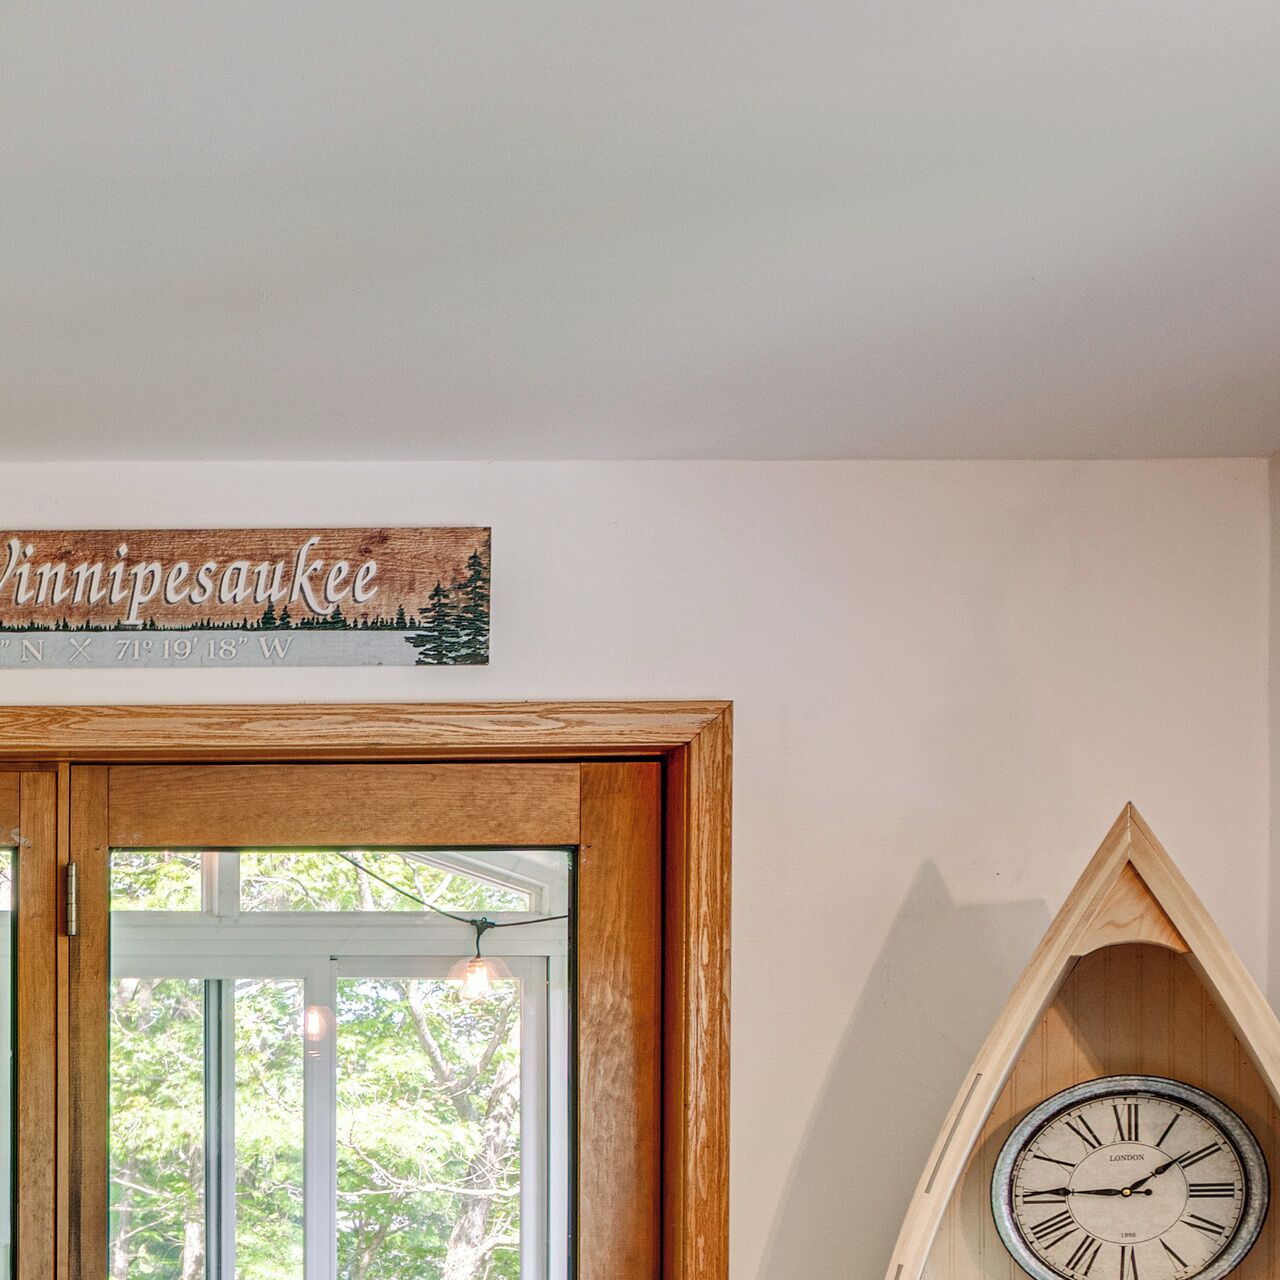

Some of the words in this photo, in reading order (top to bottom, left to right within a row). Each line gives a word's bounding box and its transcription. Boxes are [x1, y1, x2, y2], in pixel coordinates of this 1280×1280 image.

[20, 639, 45, 662] N
[258, 636, 293, 659] W
[1109, 1154, 1145, 1162] LONDON
